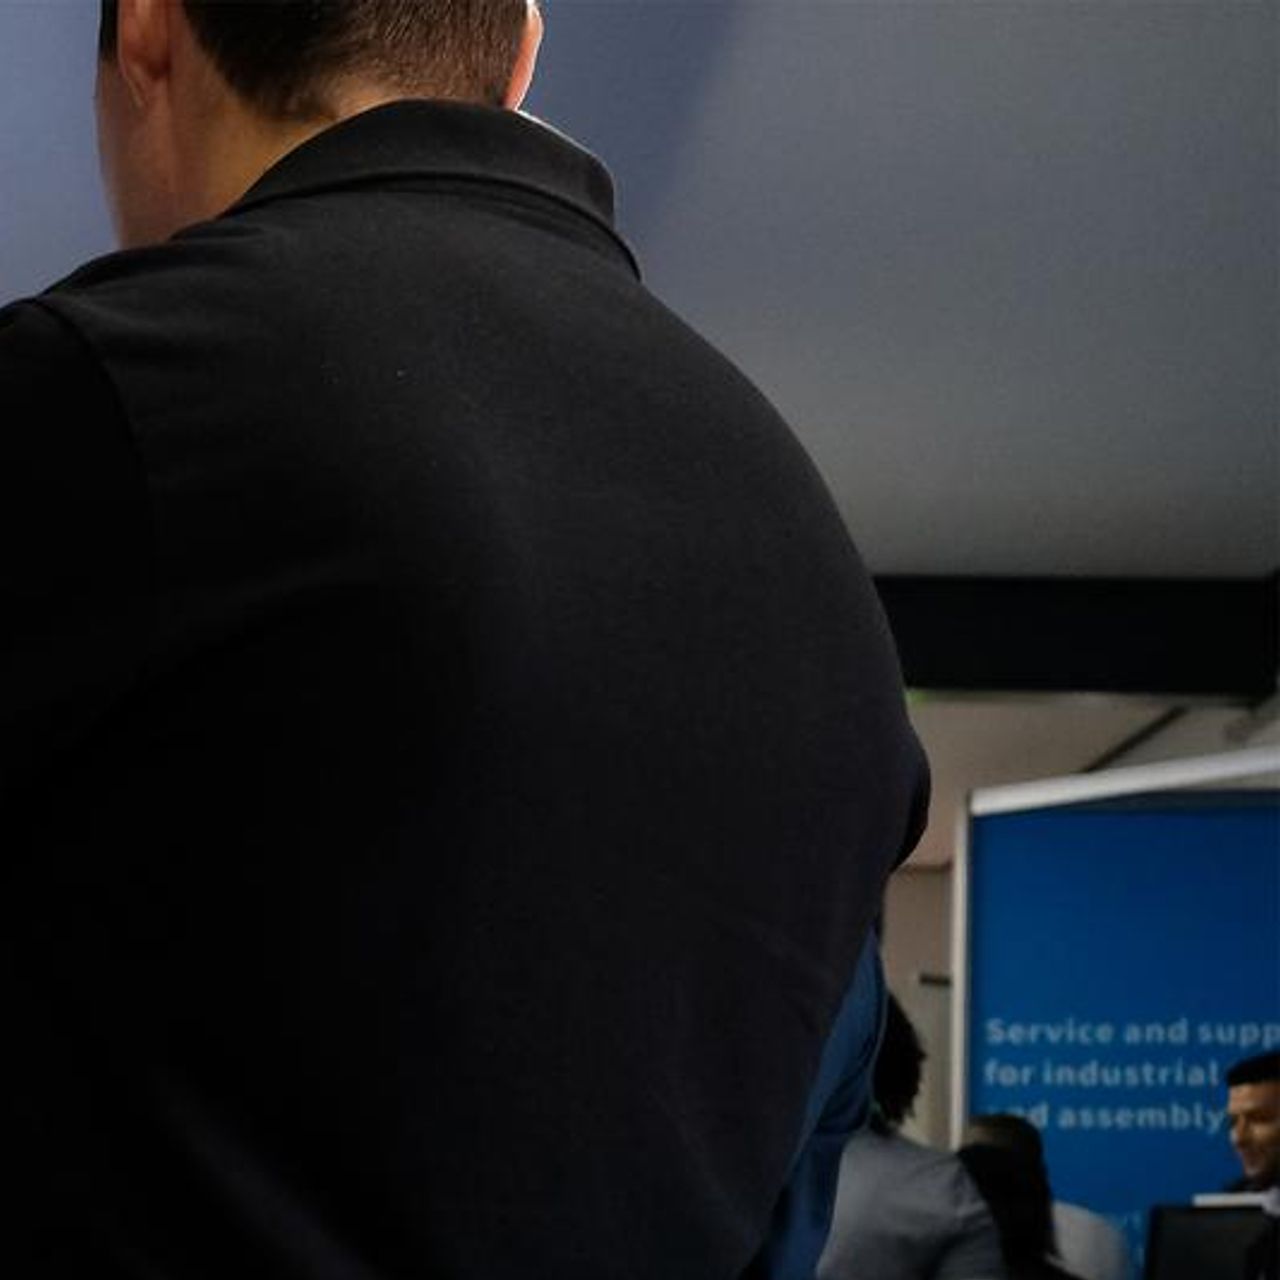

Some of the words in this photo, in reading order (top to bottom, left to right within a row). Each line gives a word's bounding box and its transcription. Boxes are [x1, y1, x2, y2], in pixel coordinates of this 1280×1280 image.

[986, 1017, 1115, 1045] Service
[1125, 1017, 1190, 1045] and
[983, 1057, 1033, 1087] for
[1043, 1058, 1220, 1087] industrial
[1057, 1102, 1227, 1135] assembly
